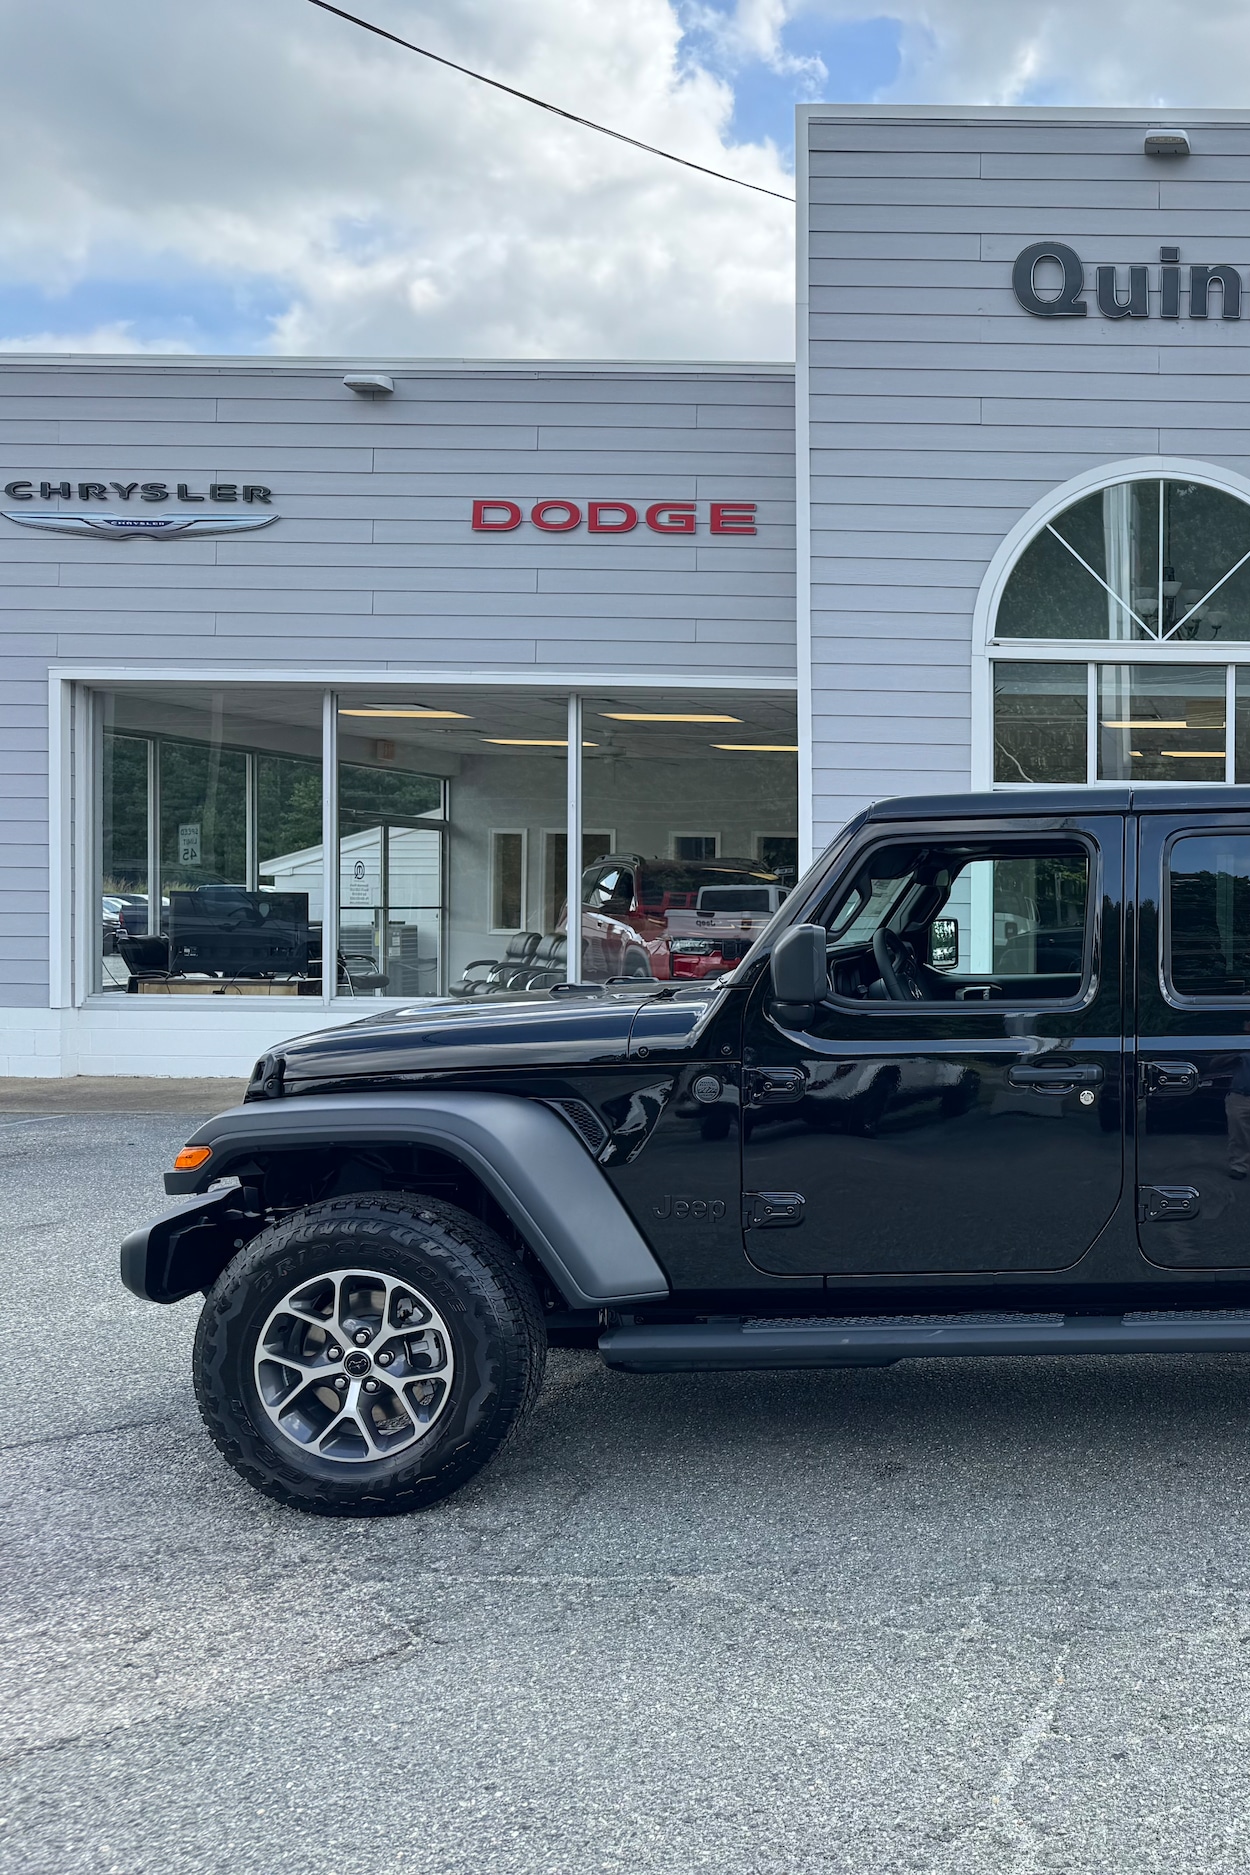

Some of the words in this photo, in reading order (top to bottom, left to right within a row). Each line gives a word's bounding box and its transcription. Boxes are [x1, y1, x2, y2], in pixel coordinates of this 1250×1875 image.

[4, 480, 272, 503] CHRYSLER
[471, 499, 757, 535] DODGE
[652, 1195, 727, 1224] Jeep
[252, 1239, 469, 1314] BRIDGESTONE
